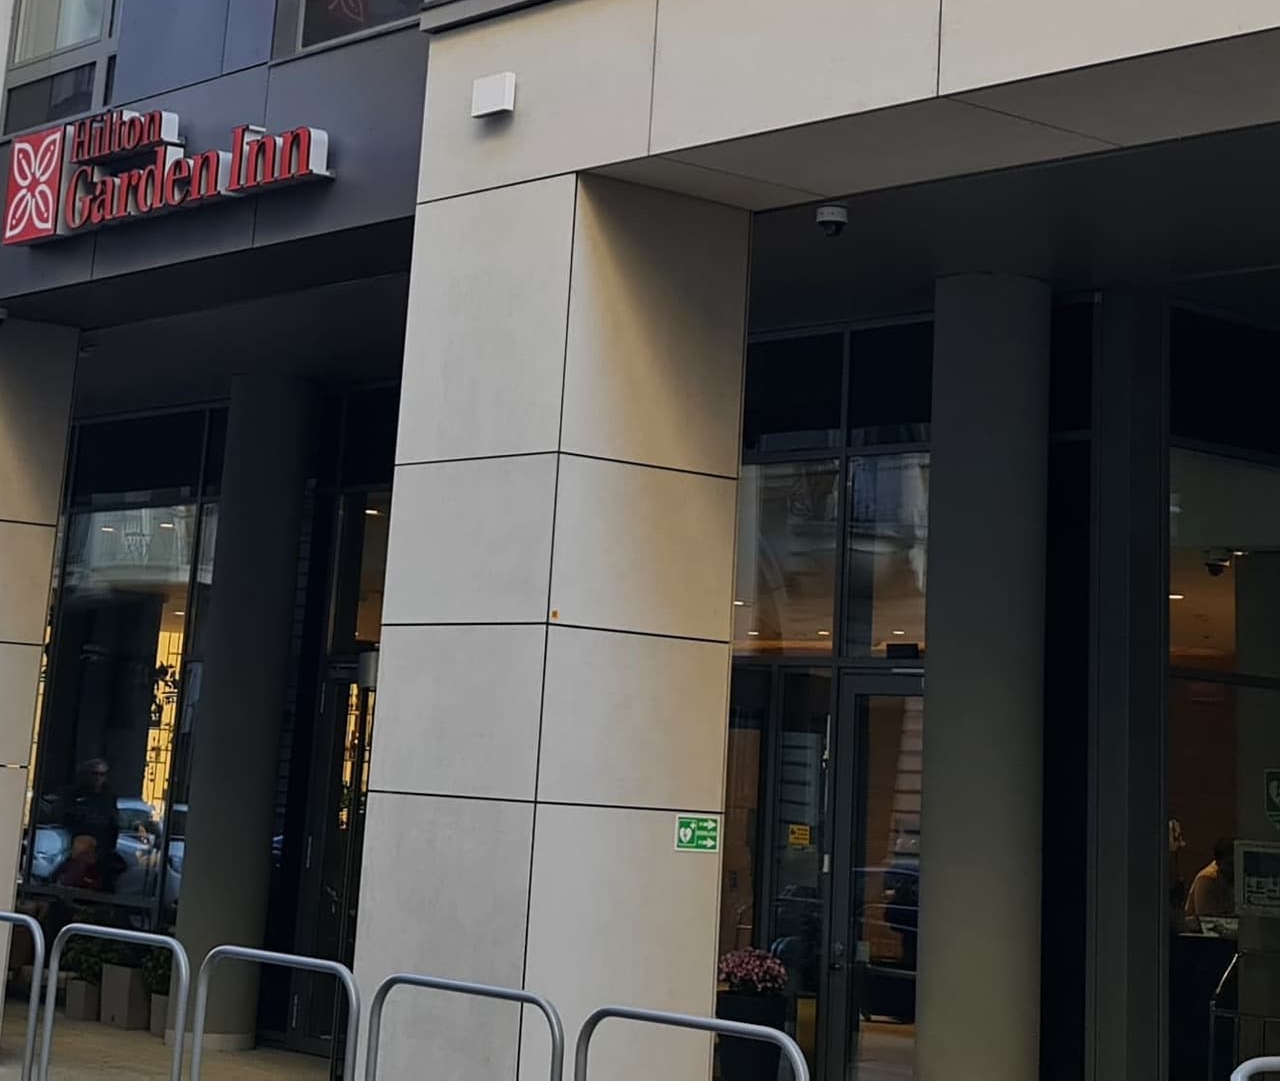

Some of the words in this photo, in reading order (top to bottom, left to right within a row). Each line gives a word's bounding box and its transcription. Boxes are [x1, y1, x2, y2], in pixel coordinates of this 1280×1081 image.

[70, 108, 164, 164] Hilton
[65, 144, 220, 229] Garden
[227, 124, 314, 191] Inn
